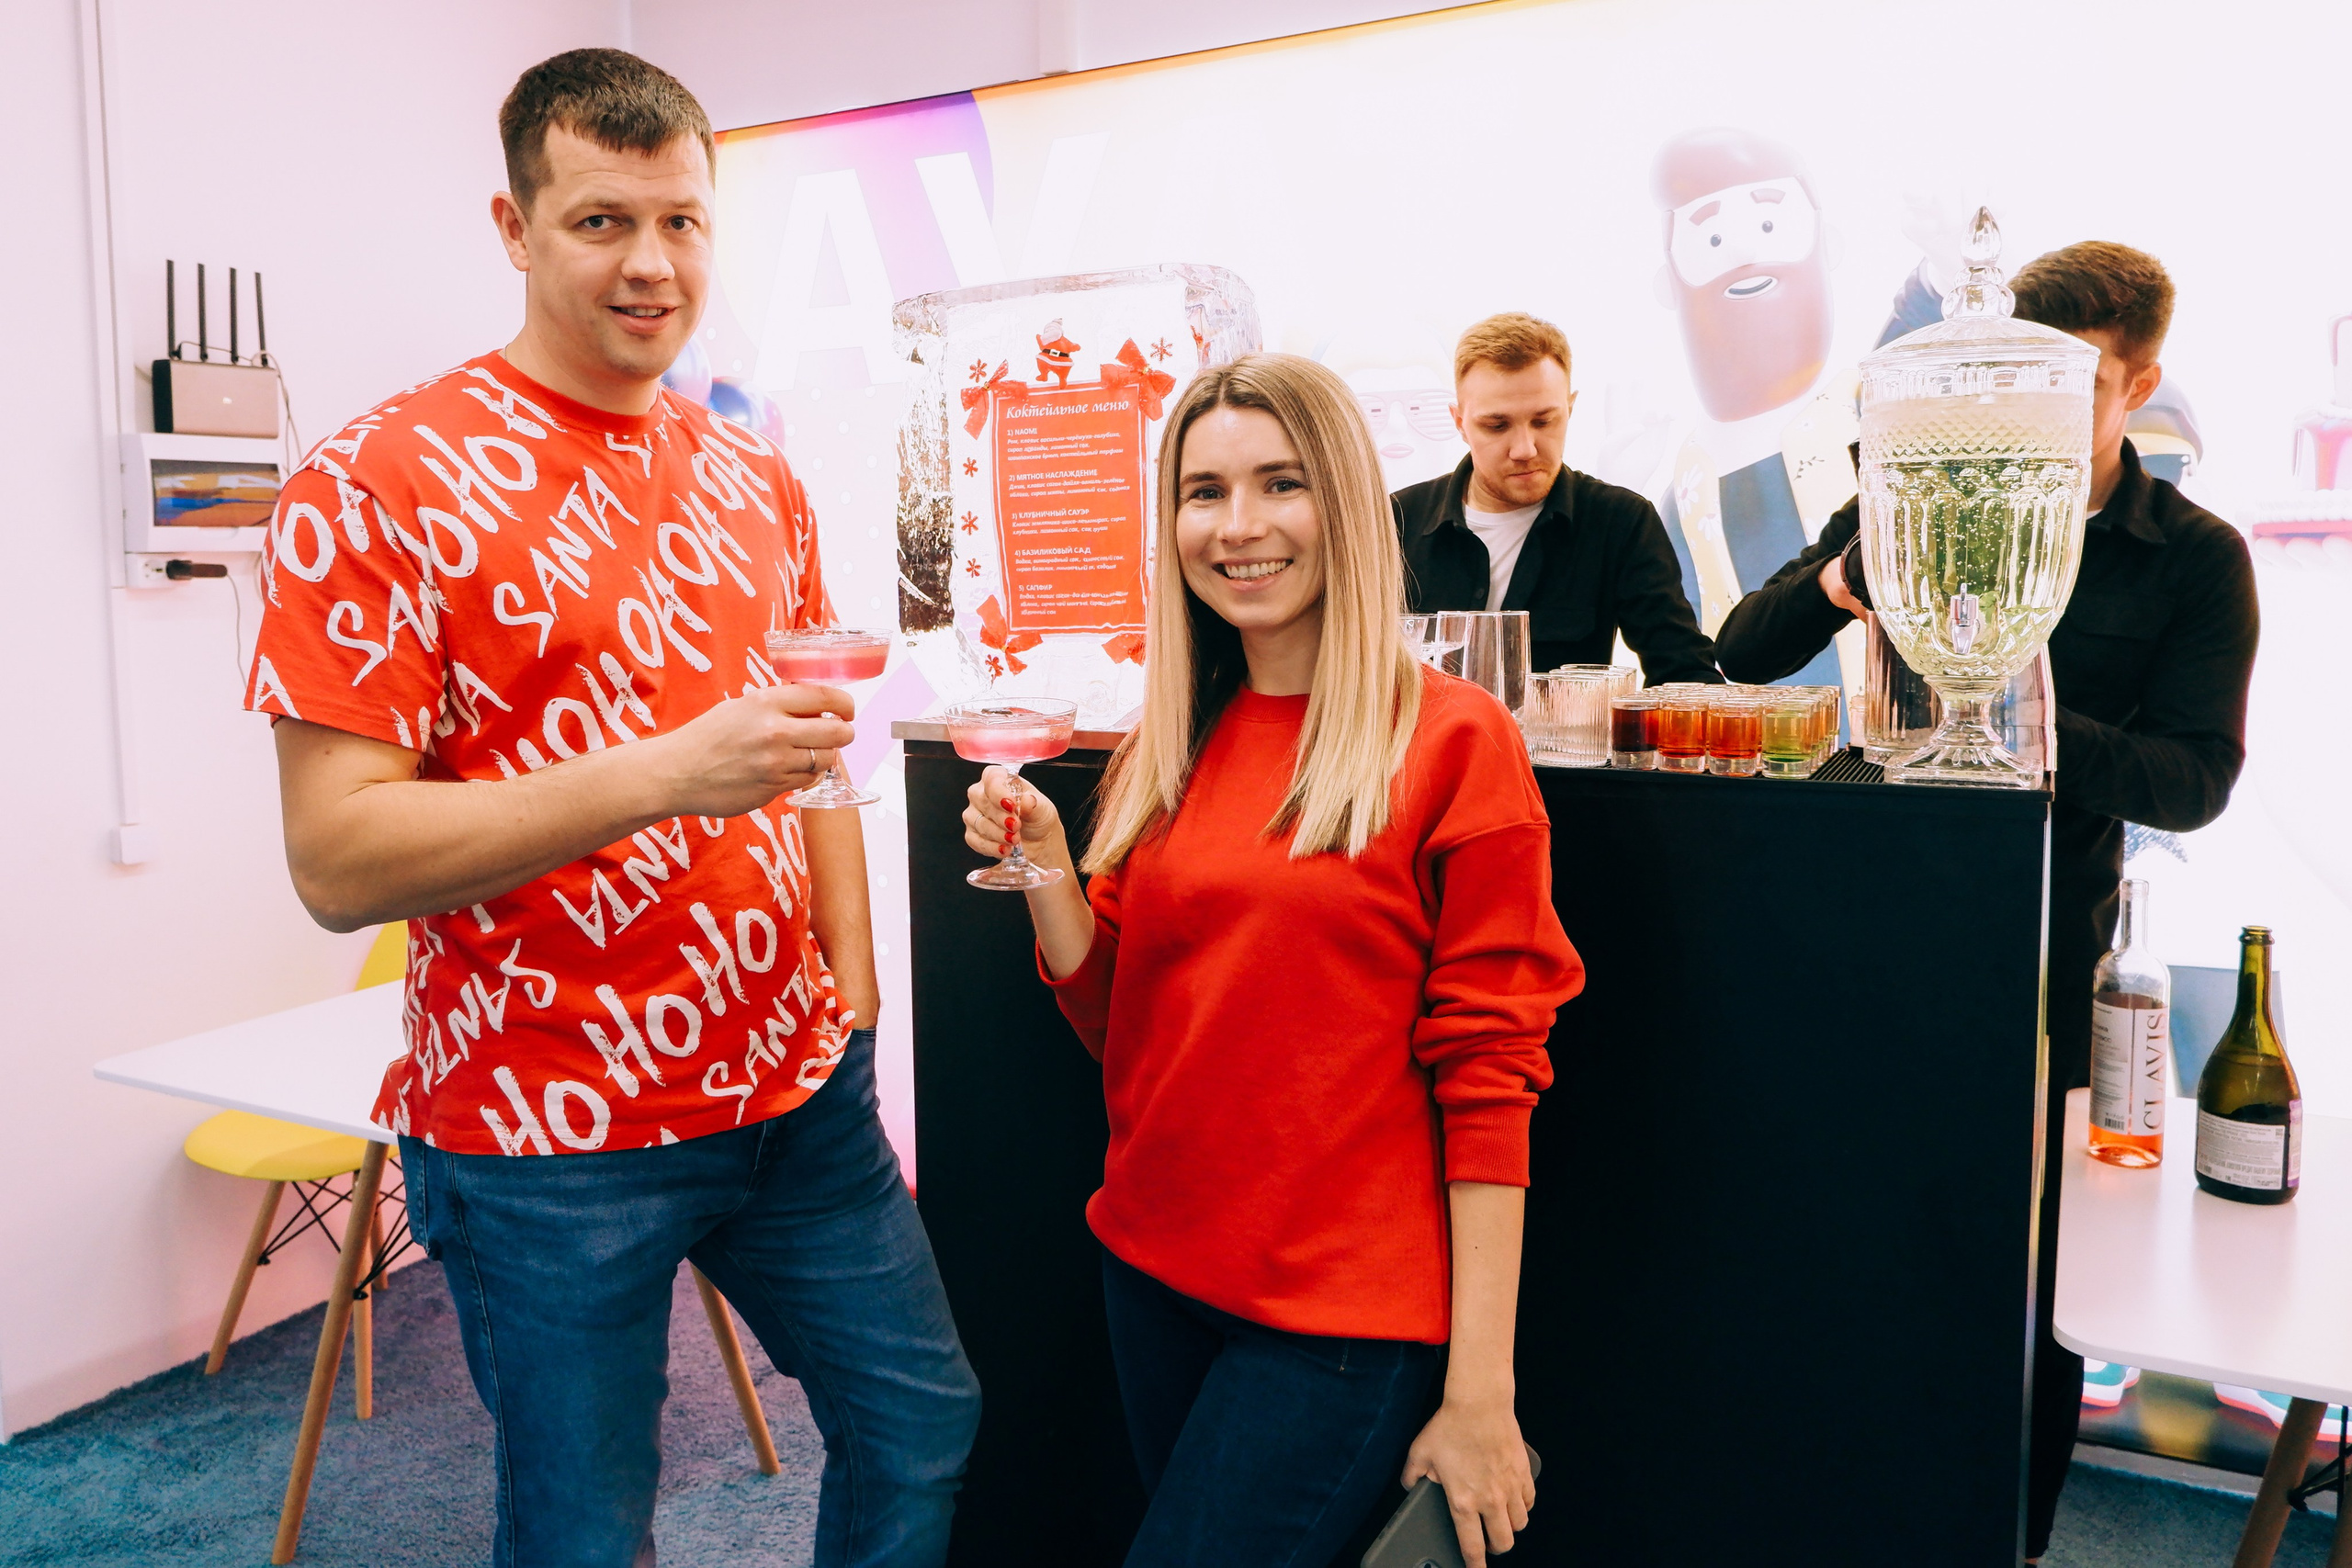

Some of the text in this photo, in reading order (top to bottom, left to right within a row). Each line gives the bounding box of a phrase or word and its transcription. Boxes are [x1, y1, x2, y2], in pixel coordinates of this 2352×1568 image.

[1006, 400, 1129, 419] Коктейльное меню
[1016, 472, 1044, 481] МЯТНОЕ
[1046, 469, 1098, 479] НАСЛАЖДЕНИЕ
[1018, 508, 1067, 519] КЛУБНИЧНЫЙ
[1022, 546, 1072, 556] БАЗИЛИКОВЫЙ
[493, 465, 640, 658] SANTA
[415, 939, 557, 1096] SANTA
